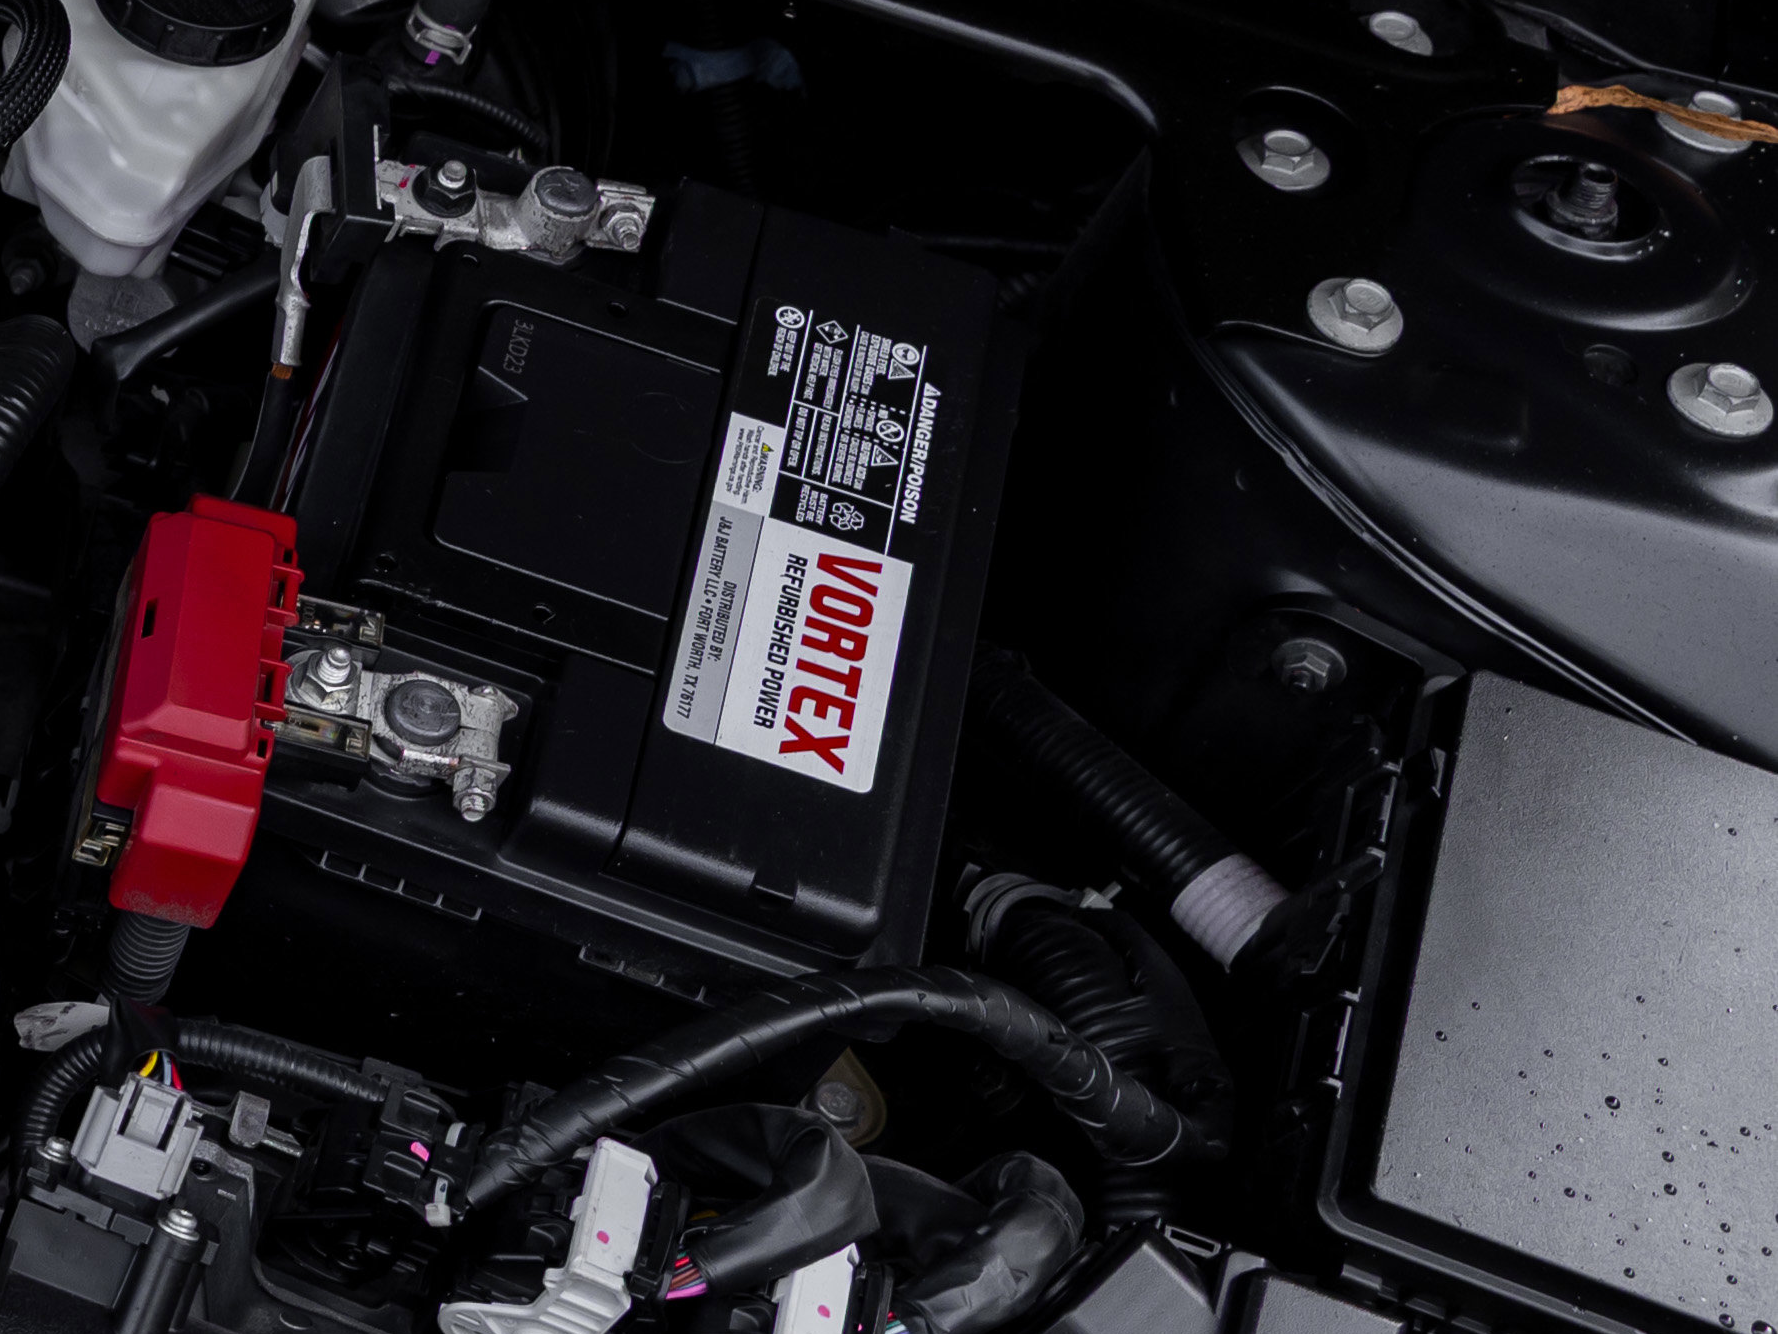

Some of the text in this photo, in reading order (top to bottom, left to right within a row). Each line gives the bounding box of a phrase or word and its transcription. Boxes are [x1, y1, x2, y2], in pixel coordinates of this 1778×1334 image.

[501, 317, 535, 375] 3LKD23
[752, 450, 769, 494] WARNING:
[898, 396, 938, 524] DANGER/POISON
[795, 483, 810, 522] RECYCLED
[805, 489, 818, 521] MUST BE
[813, 492, 827, 524] BATTERY
[675, 515, 732, 719] J&J BATTERY LLC FORT WORTH, TX 76177
[706, 579, 737, 663] DISTRIBUTED BY:
[753, 552, 808, 730] REFURBISHED POWER
[778, 553, 884, 775] VORTEX
